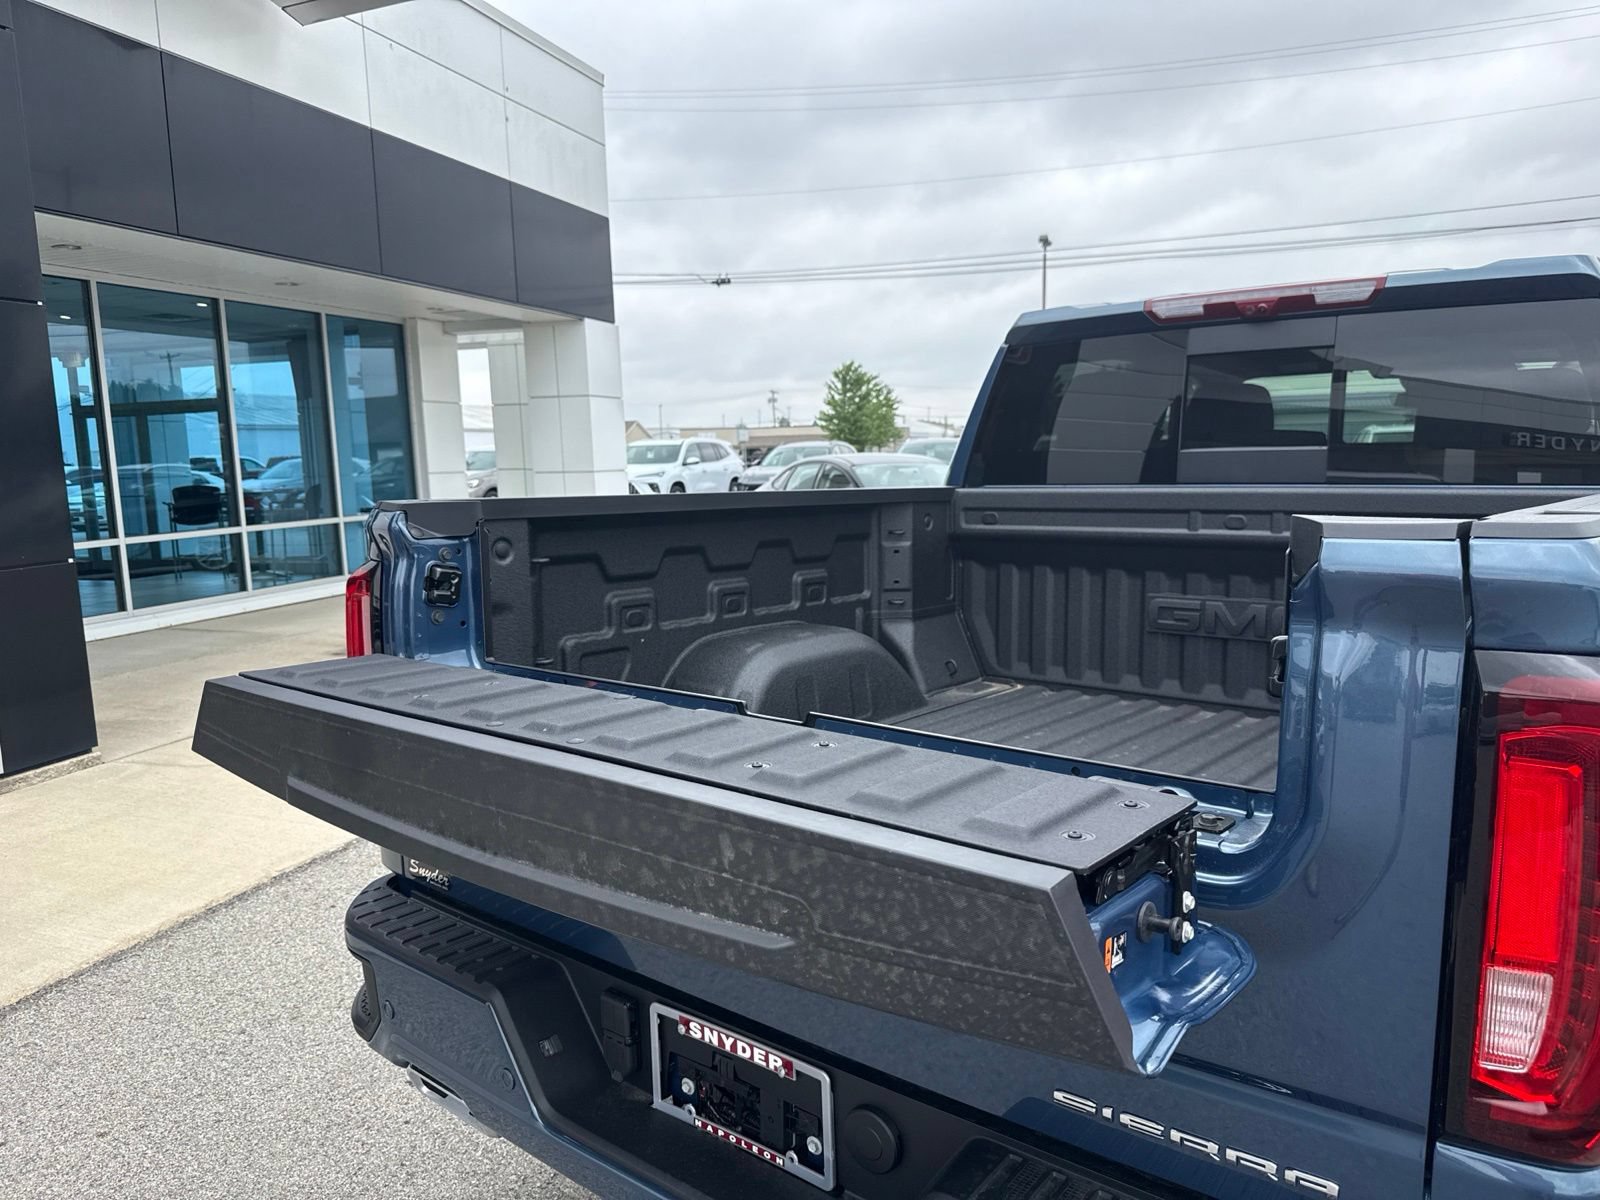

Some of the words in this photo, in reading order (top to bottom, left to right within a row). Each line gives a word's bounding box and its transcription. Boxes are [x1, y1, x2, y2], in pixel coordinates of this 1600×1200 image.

[1149, 598, 1285, 638] GM
[409, 858, 449, 886] Snyder
[688, 1021, 783, 1071] SNYDER
[695, 1119, 783, 1166] NAPOLEON
[1052, 1088, 1340, 1198] SIERRA
